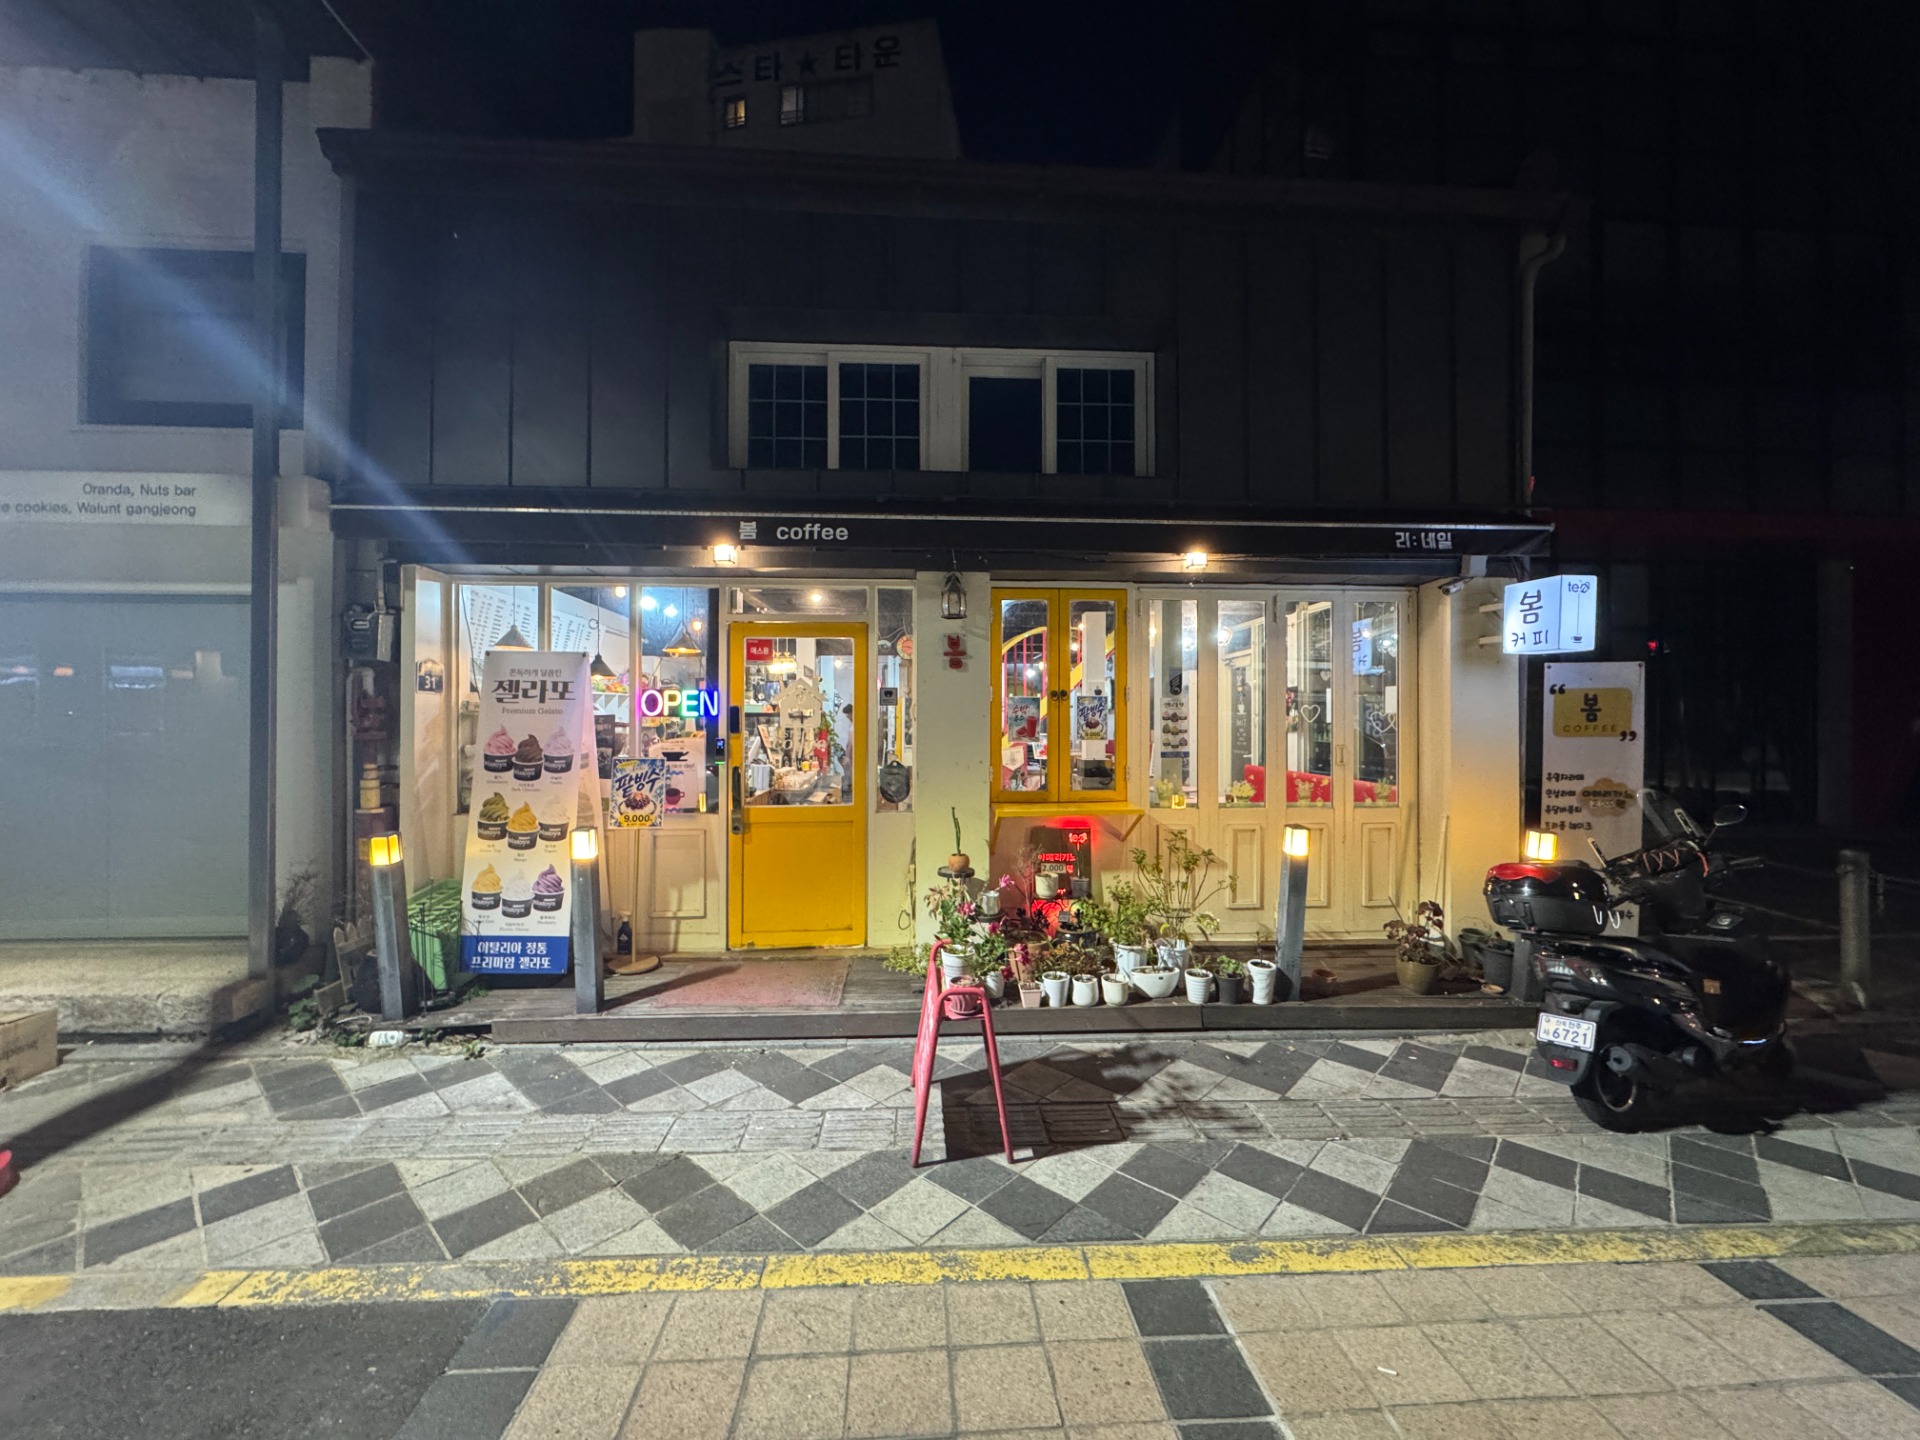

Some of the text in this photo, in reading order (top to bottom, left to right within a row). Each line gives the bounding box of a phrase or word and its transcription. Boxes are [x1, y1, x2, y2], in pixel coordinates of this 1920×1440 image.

[82, 483, 196, 497] Oranda, Nuts bar
[15, 501, 72, 515] cookies,
[77, 502, 121, 514] Walunt
[126, 503, 196, 517] gangjeong
[739, 521, 849, 540] 봄 coffee
[1519, 589, 1544, 625] 봄
[1511, 629, 1549, 647] 커피
[424, 675, 436, 689] 31
[491, 680, 576, 704] 젤라또
[537, 707, 563, 715] Gelato
[640, 689, 718, 717] OPEN
[1580, 692, 1602, 723] 봄
[1562, 724, 1618, 733] COFFEE
[615, 768, 660, 798] 팥빙수
[477, 942, 547, 955] 이탈리아 정통
[471, 957, 551, 969] 프리미엄 젤라또
[1552, 1027, 1588, 1045] 6721
